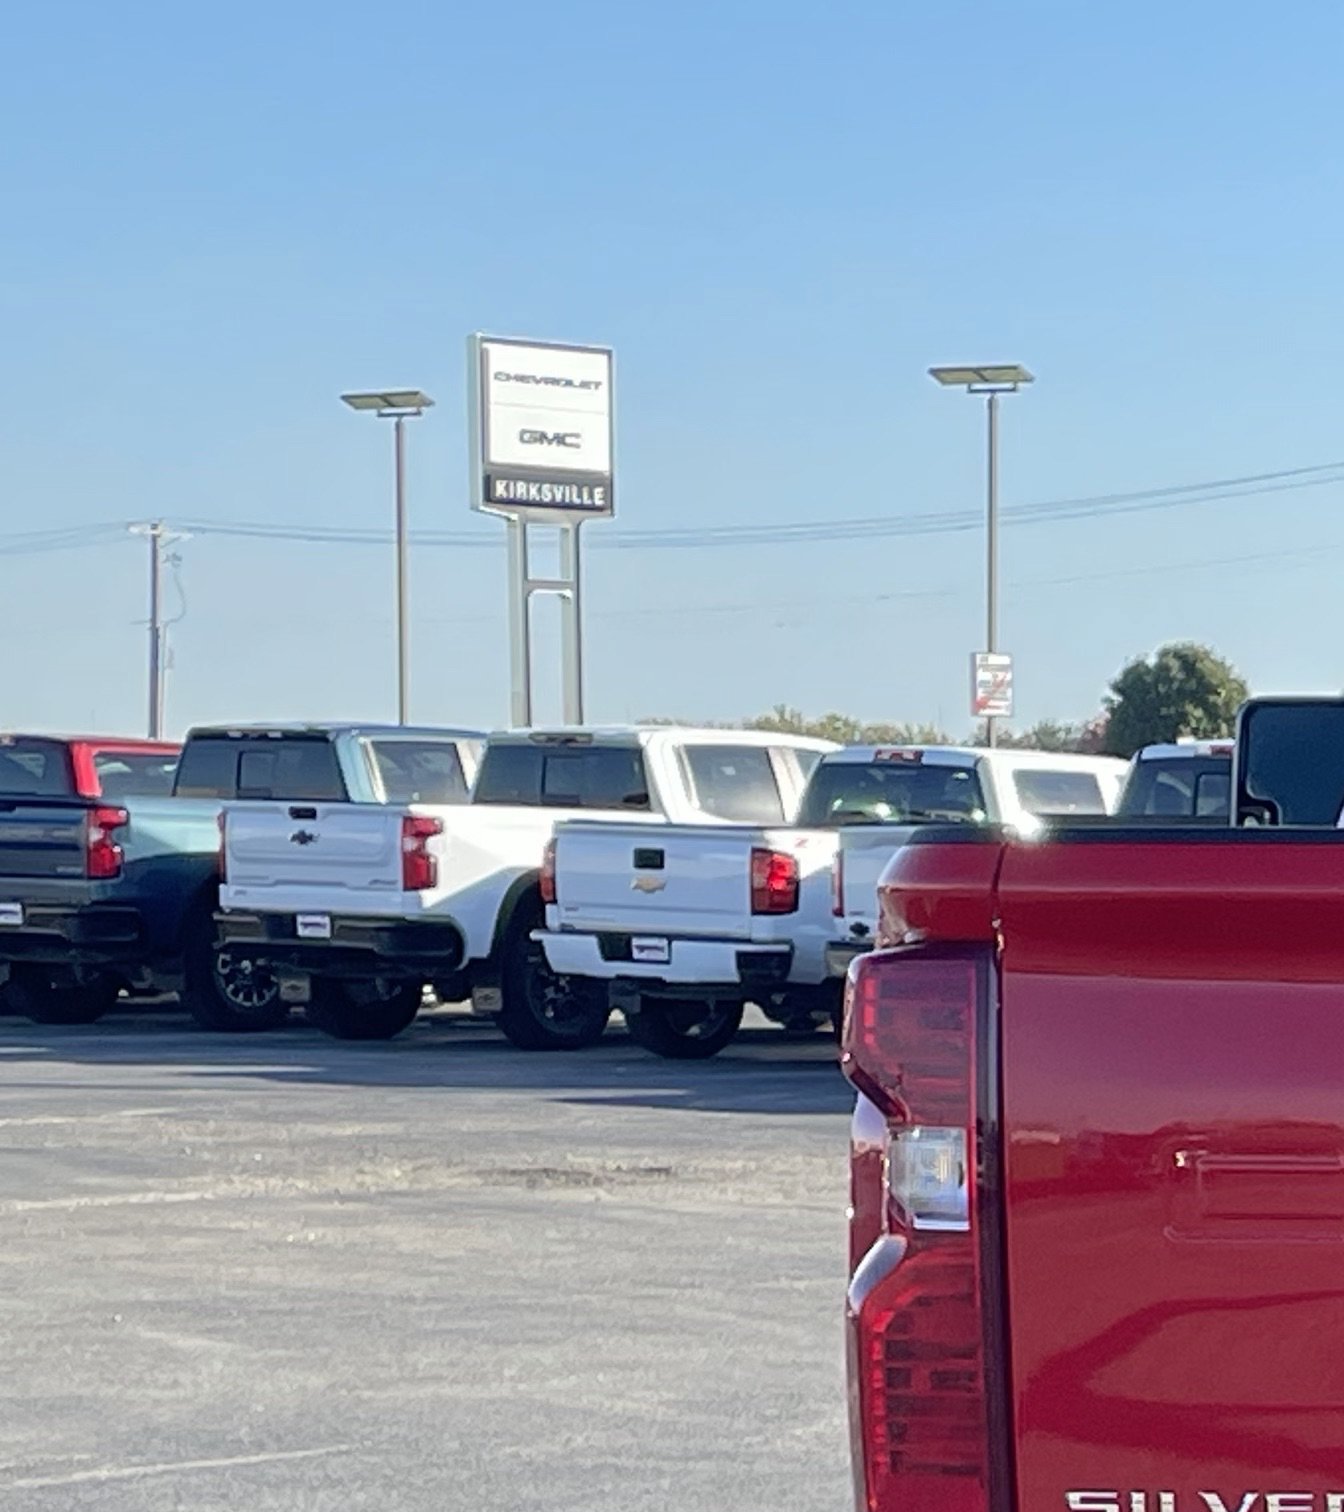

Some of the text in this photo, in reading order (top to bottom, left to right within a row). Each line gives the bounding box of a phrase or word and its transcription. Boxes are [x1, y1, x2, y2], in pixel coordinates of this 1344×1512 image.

[493, 371, 602, 390] CHEVROLET
[519, 428, 581, 449] GMC
[495, 479, 605, 506] KIRKSVILLE
